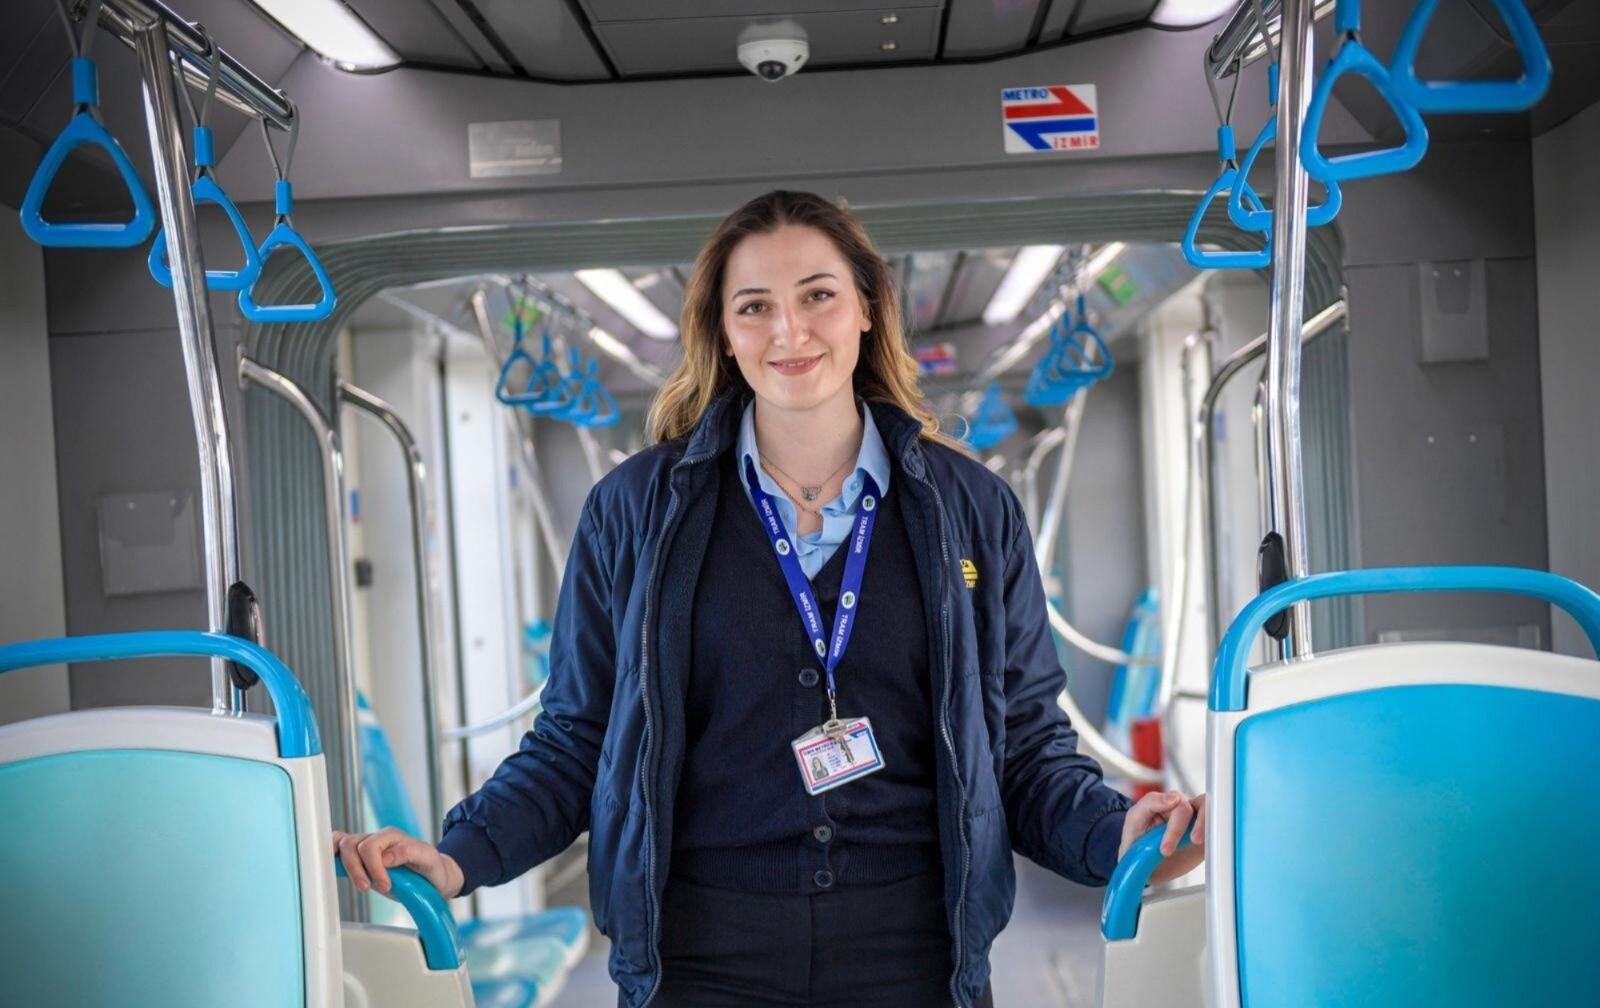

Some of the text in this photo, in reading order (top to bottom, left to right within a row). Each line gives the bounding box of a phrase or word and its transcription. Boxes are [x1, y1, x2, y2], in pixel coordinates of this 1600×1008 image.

[1003, 88, 1048, 100] METRO
[769, 517, 780, 535] TRAM
[859, 516, 868, 534] TRAM
[807, 611, 819, 633] TRAM
[838, 614, 849, 637] TRAM
